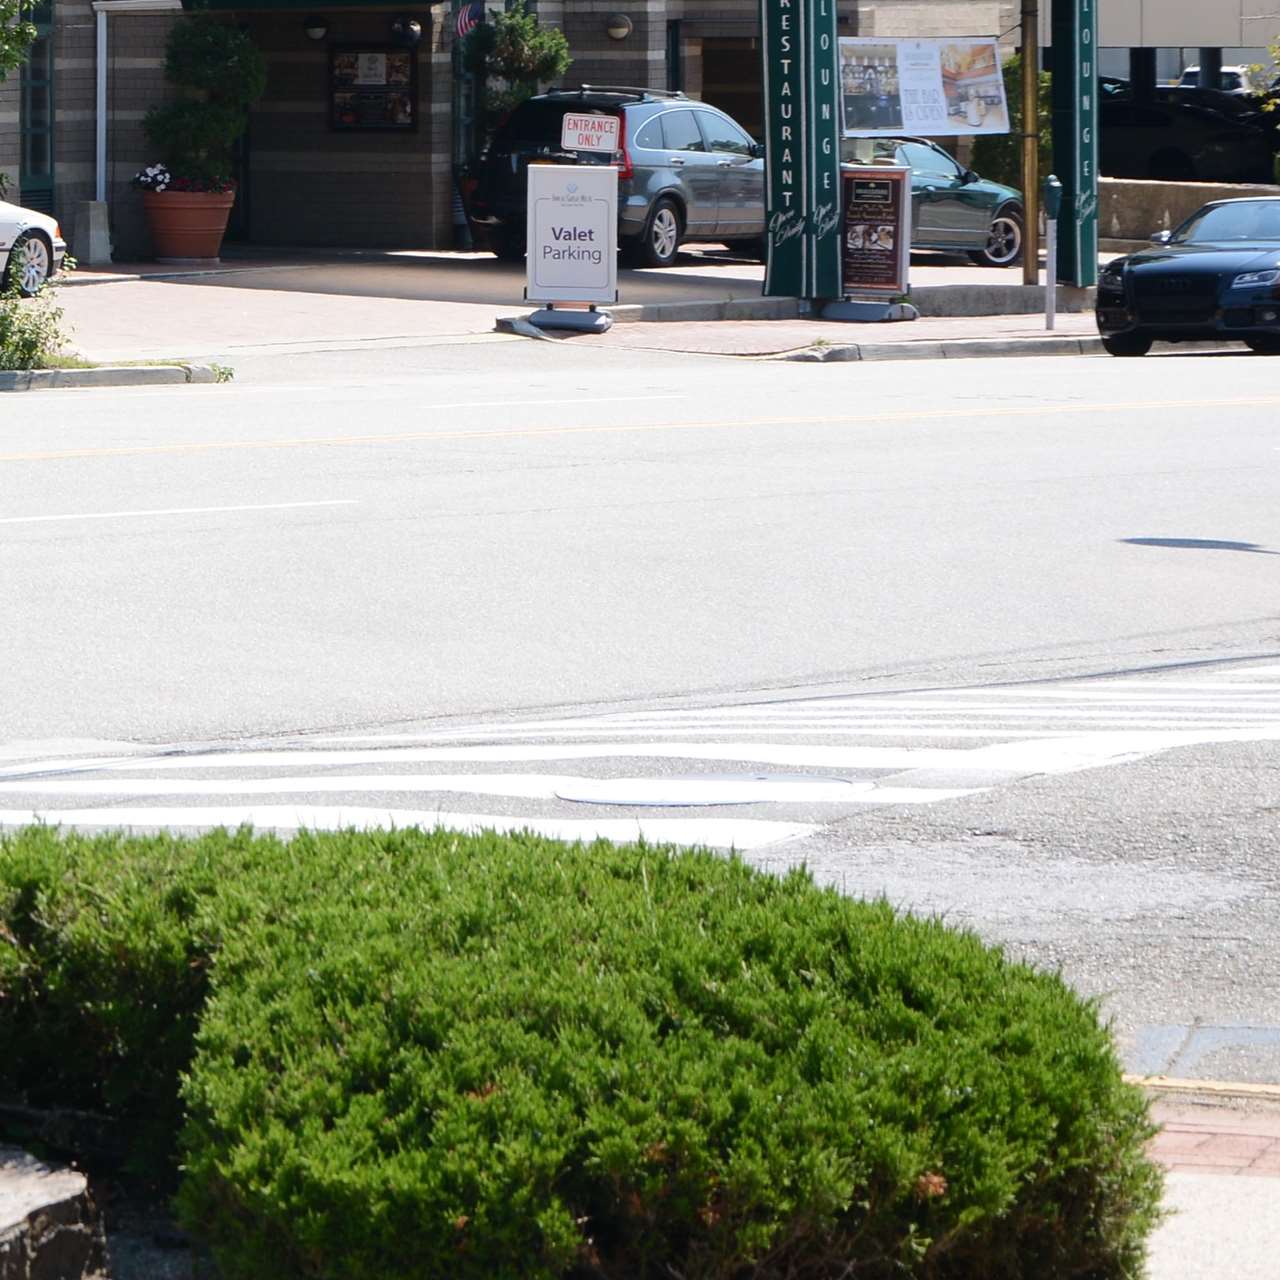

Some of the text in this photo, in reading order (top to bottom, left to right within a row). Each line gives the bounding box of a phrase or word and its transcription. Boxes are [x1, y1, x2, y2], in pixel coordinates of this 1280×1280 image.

[820, 0, 831, 190] LOUNGE
[567, 118, 615, 134] ENTRANCE
[577, 133, 603, 147] ONLY
[551, 226, 595, 242] Valet
[543, 245, 602, 265] Parking
